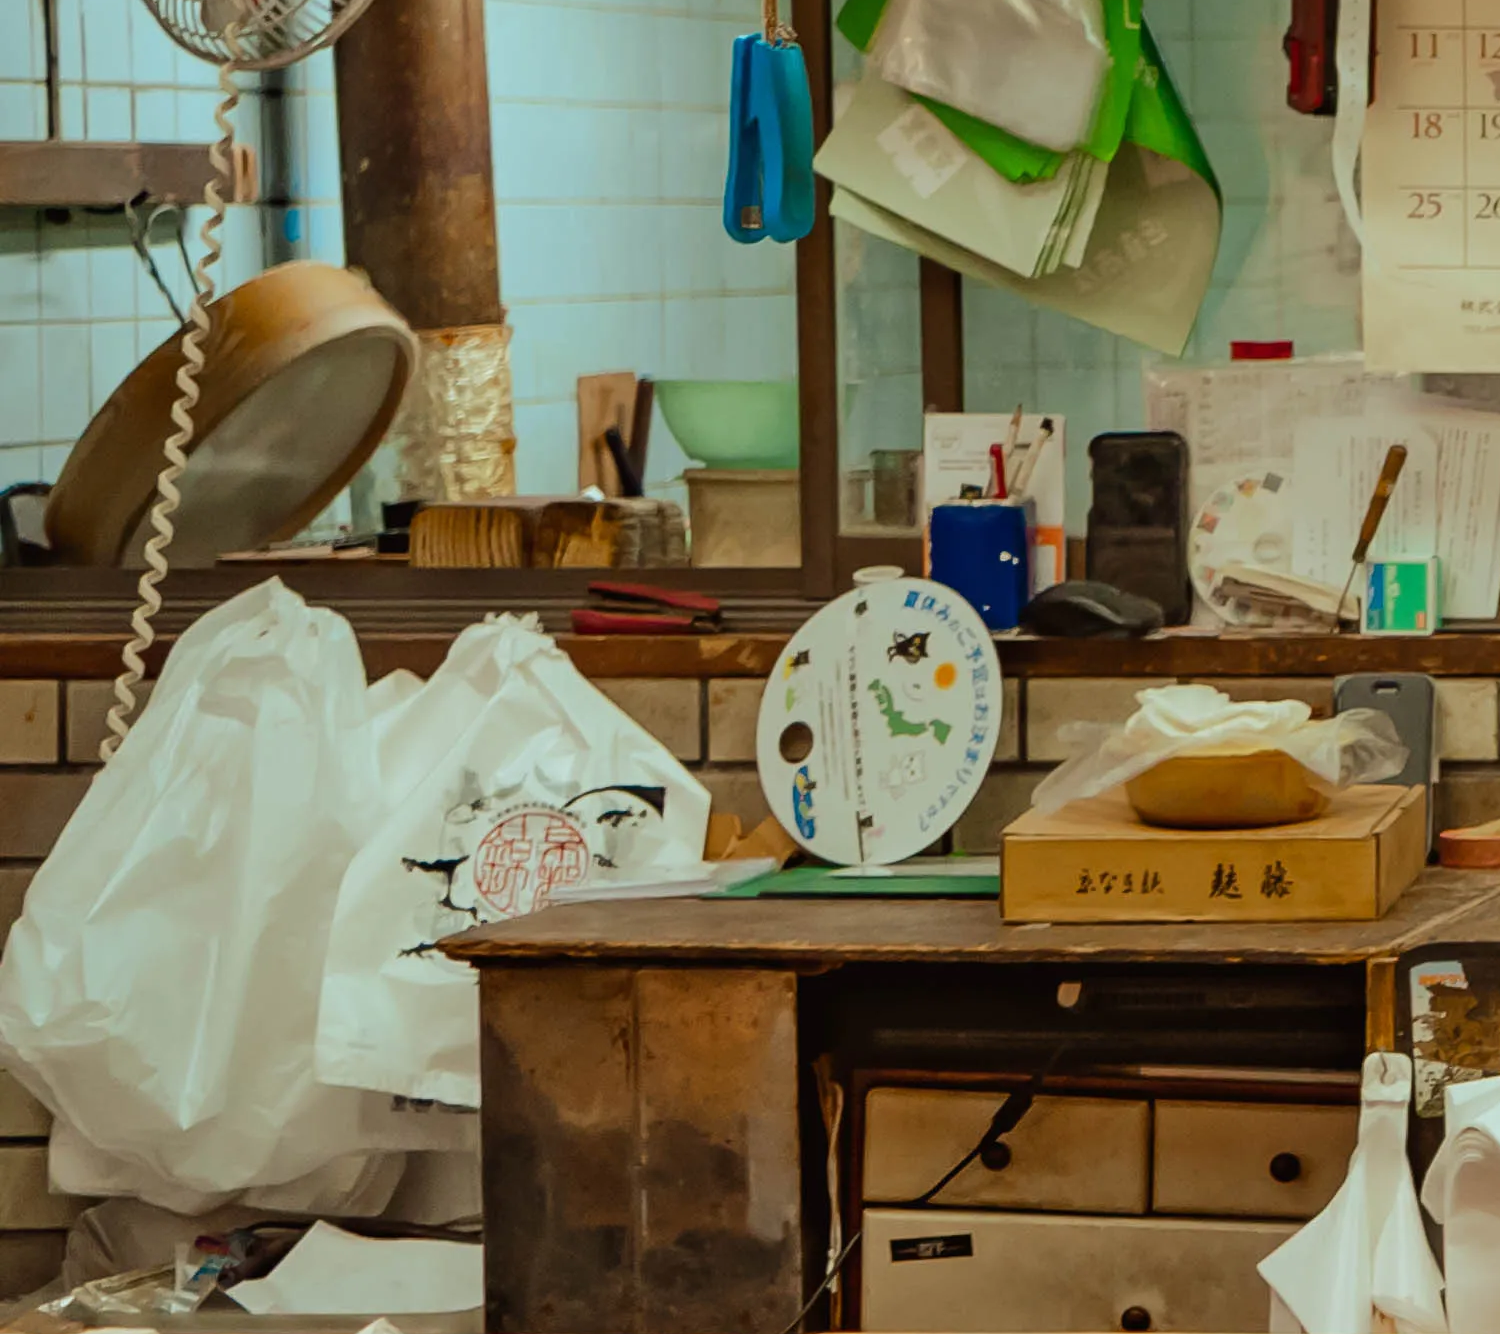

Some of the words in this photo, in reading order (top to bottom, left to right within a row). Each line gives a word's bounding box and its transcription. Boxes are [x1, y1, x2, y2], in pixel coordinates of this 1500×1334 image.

[1410, 33, 1438, 59] 11
[1411, 112, 1443, 139] 18
[1407, 193, 1443, 219] 25
